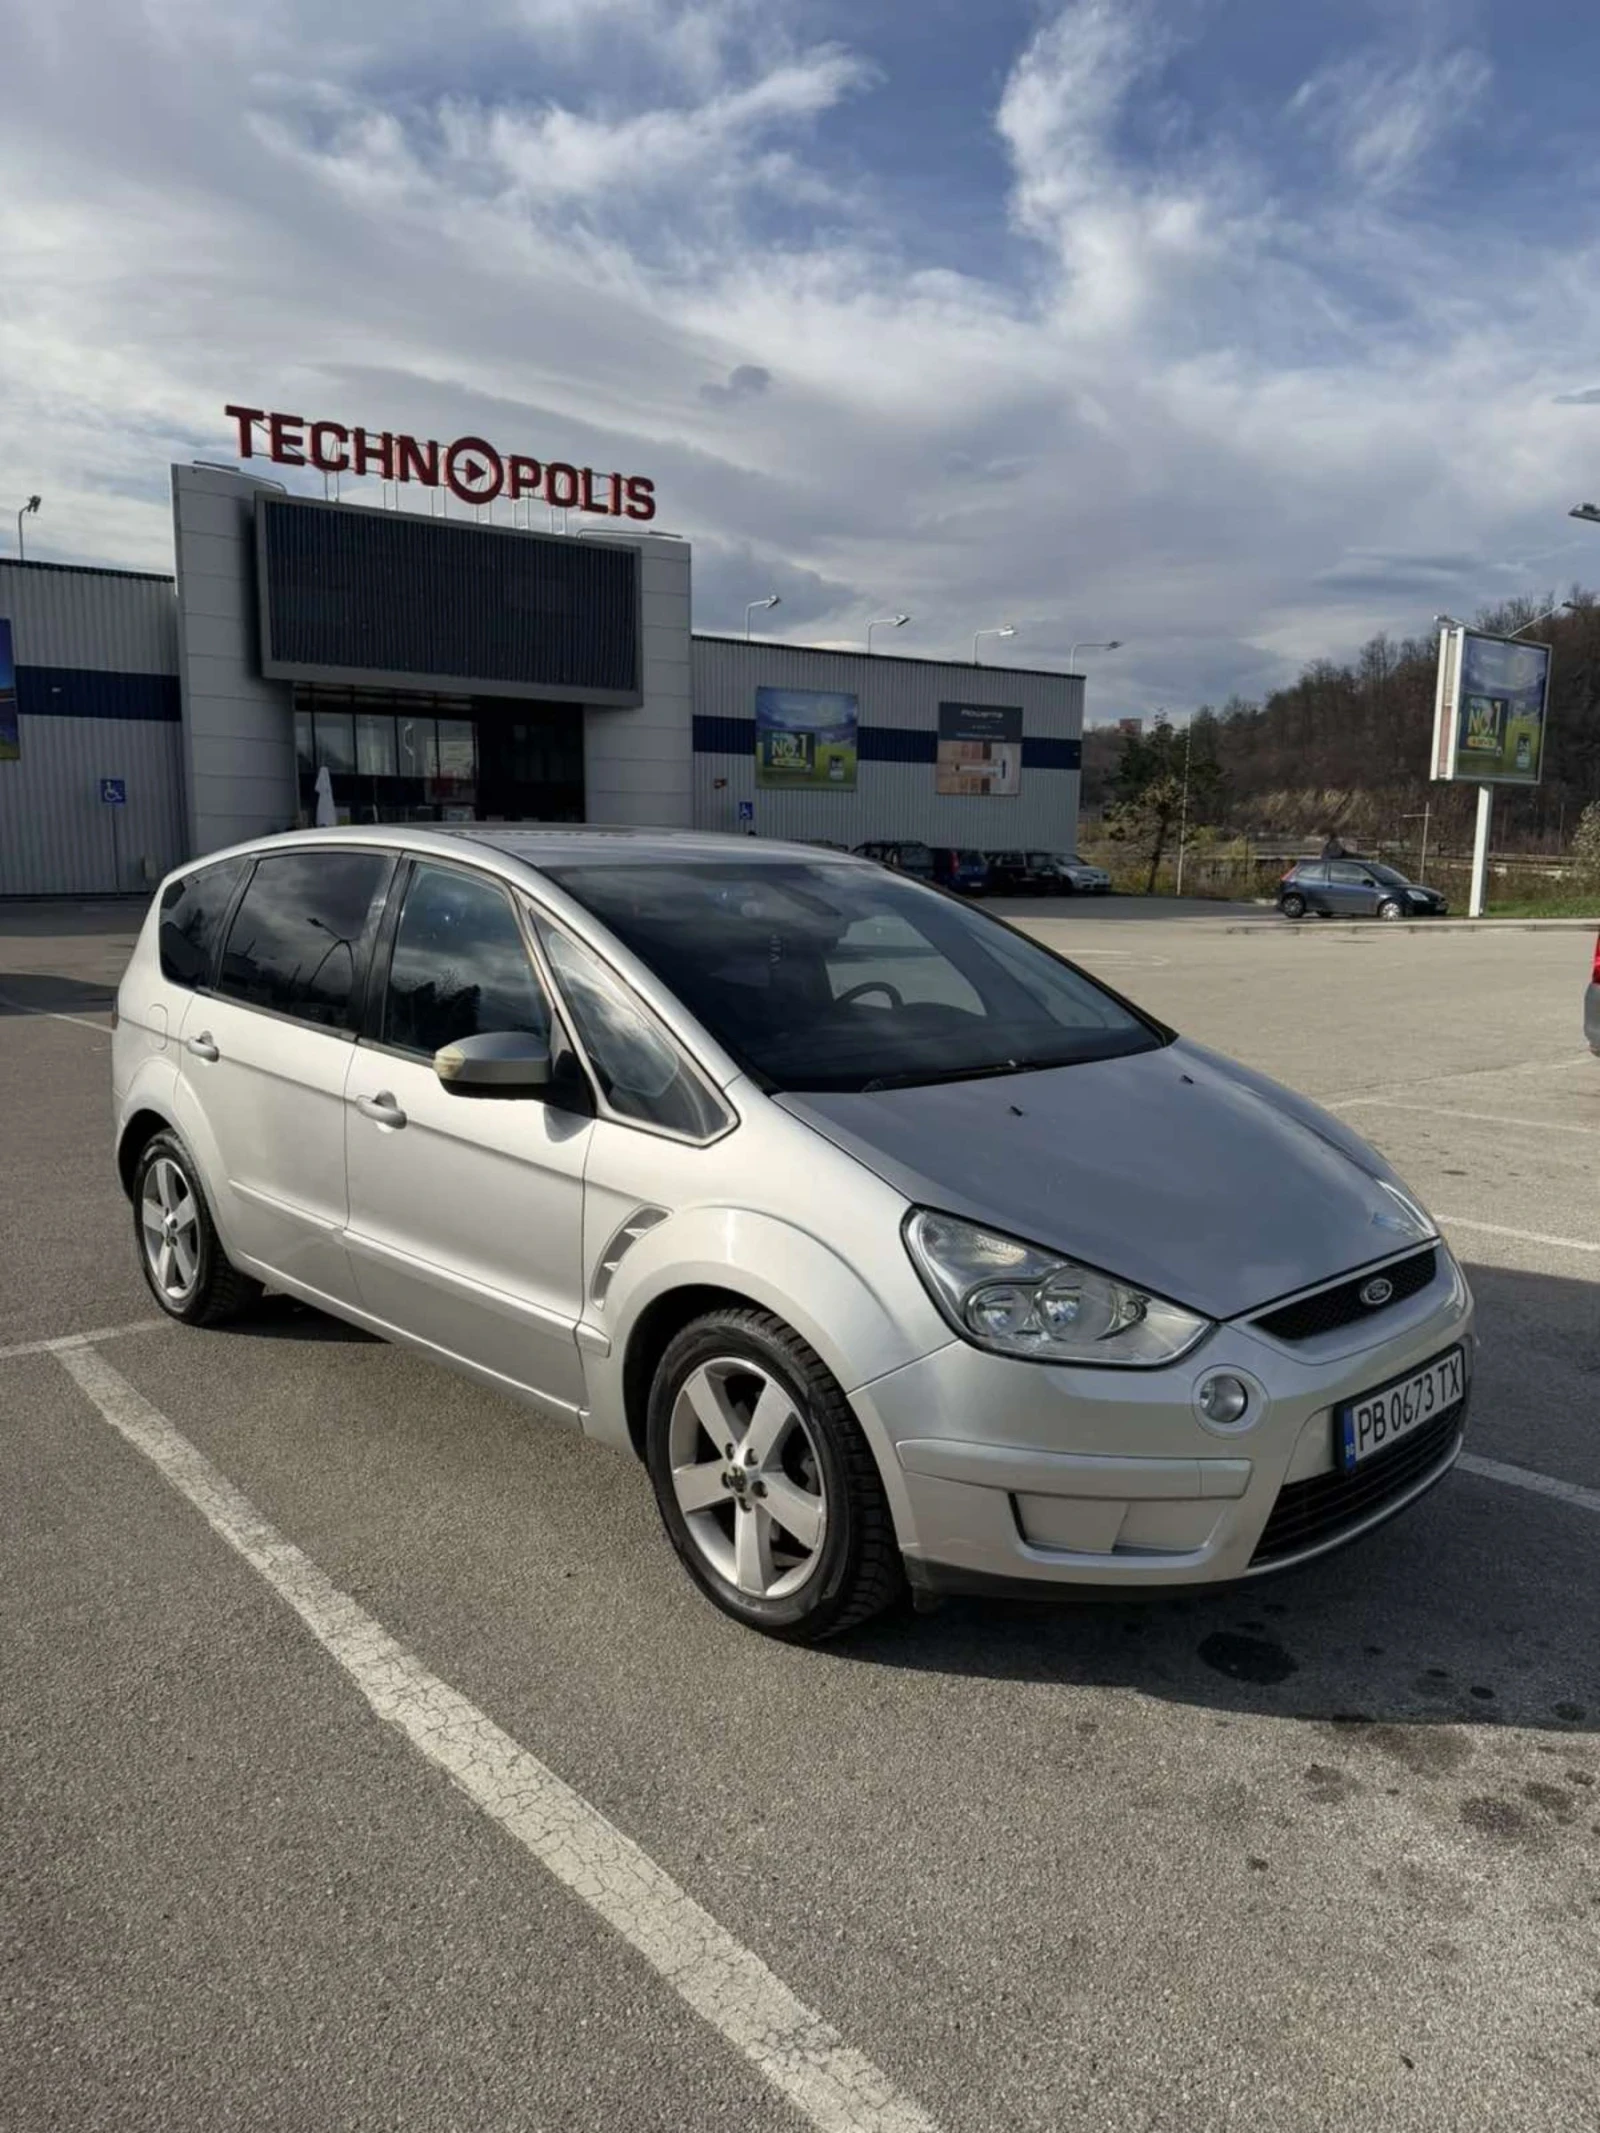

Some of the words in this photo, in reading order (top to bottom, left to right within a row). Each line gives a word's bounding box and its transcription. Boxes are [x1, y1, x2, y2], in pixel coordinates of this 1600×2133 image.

[225, 405, 656, 520] TECHNOPOLIS
[1358, 1401, 1386, 1451] PB
[1391, 1373, 1434, 1431] 0673
[1438, 1356, 1460, 1402] TX
